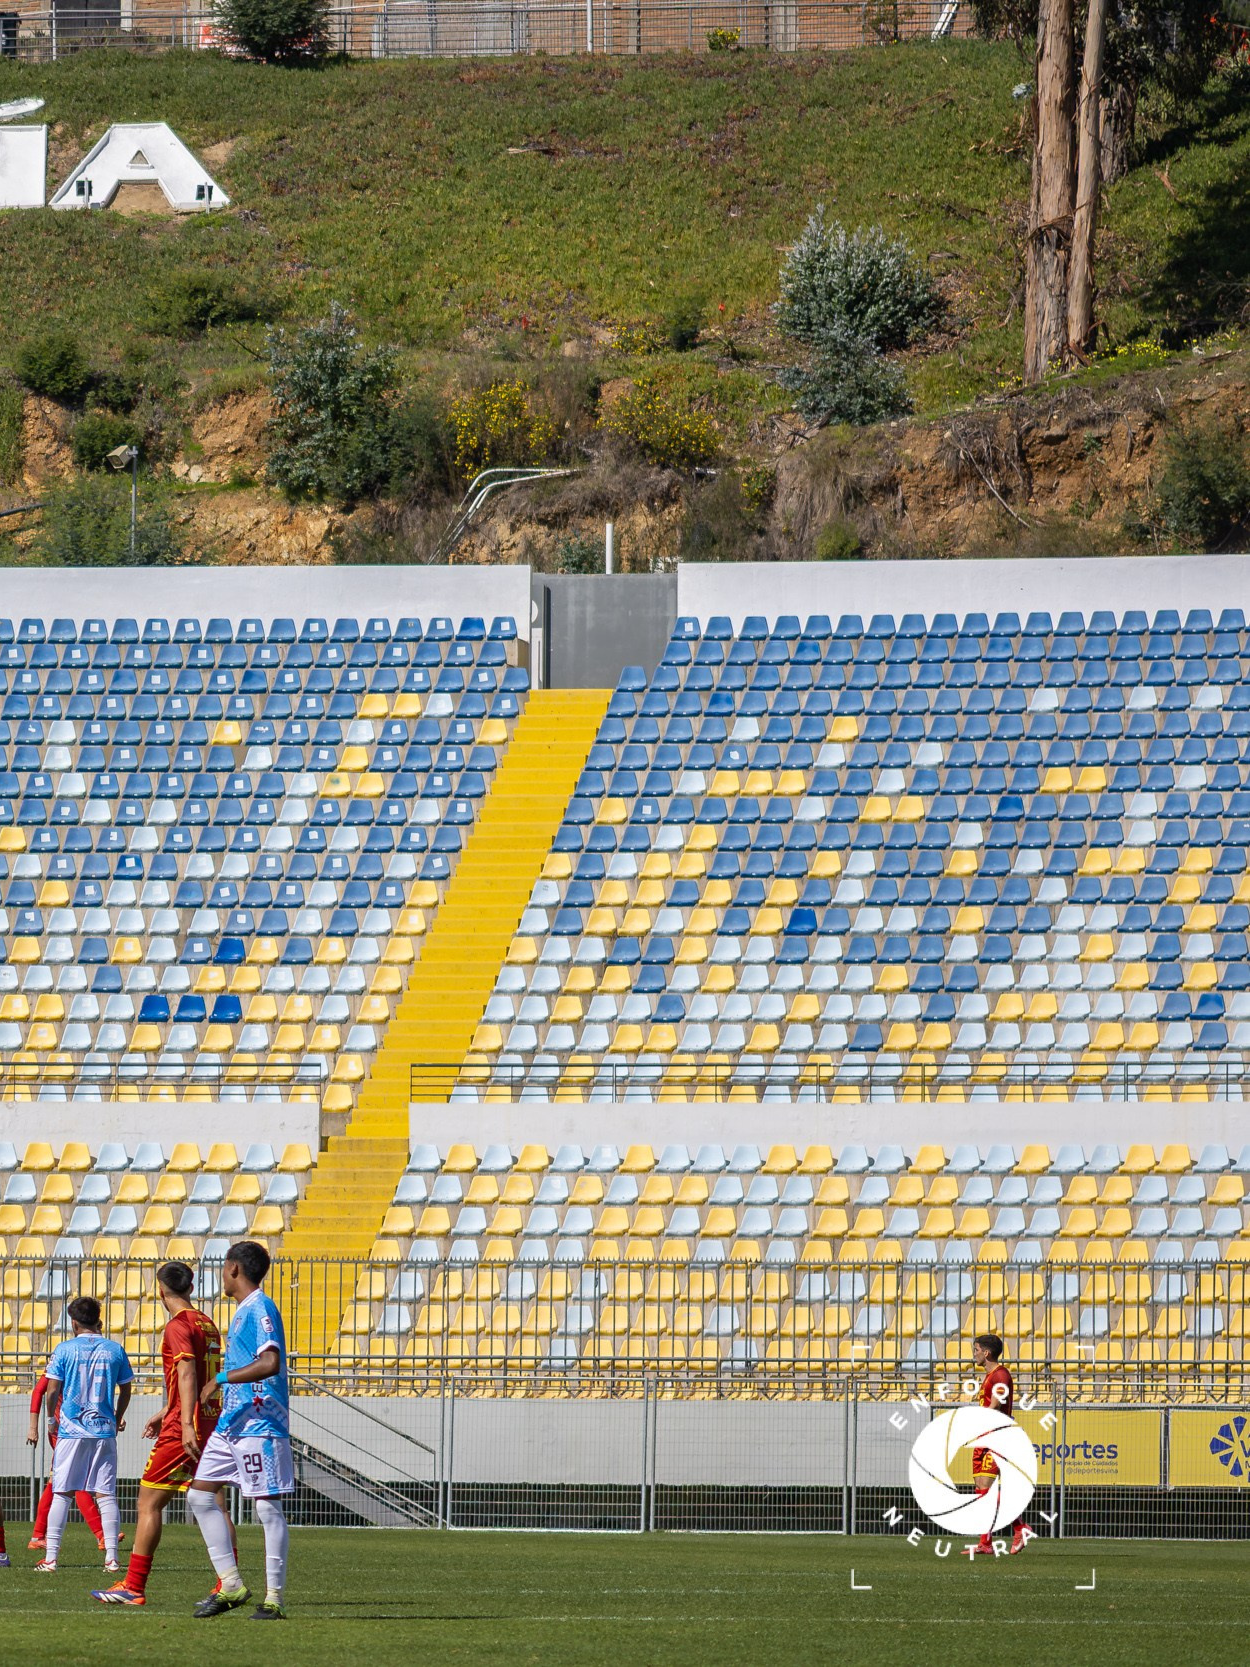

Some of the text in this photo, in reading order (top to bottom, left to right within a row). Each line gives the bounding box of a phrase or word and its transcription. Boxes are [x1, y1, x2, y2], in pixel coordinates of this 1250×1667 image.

[243, 1452, 263, 1474] 29
[1031, 1440, 1119, 1465] eportes
[1056, 1460, 1082, 1468] Mnicipio
